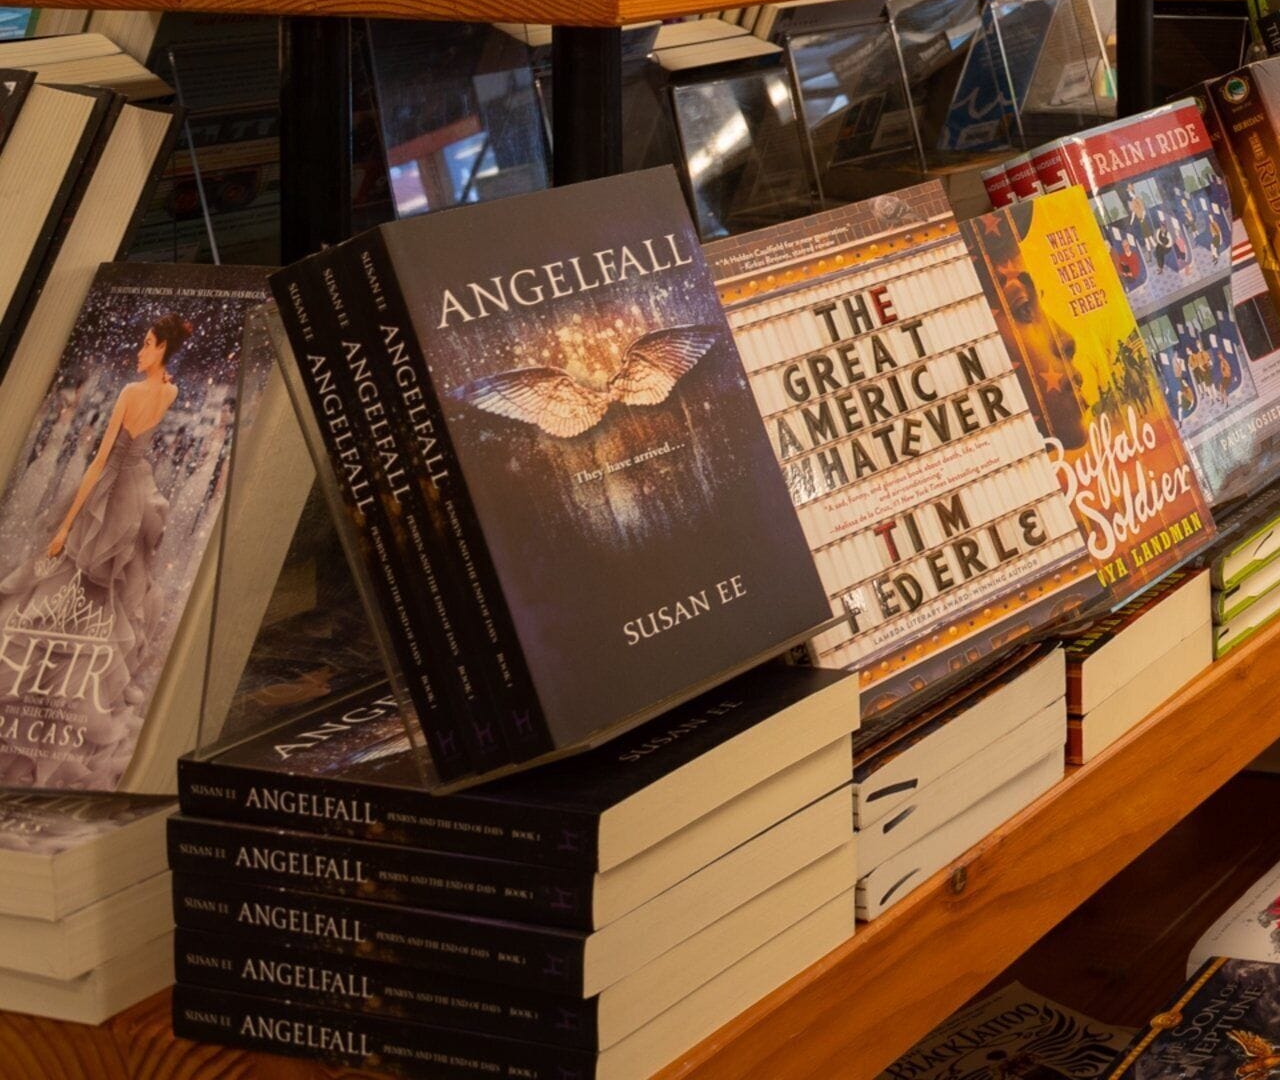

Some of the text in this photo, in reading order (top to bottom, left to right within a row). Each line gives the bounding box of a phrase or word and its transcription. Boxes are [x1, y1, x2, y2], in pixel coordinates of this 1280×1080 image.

[1155, 122, 1201, 155] RIDE
[1044, 225, 1081, 250] WHAT
[1048, 241, 1088, 267] DOES IT
[436, 233, 693, 330] ANGELFALL
[1056, 256, 1096, 285] MEAN
[1068, 273, 1099, 297] TO BE
[813, 285, 899, 343] THE
[1068, 289, 1110, 320] FREE?
[782, 318, 929, 403] GREAT
[307, 352, 375, 516] ANGELFALL
[786, 383, 1013, 506] WHATEVER
[574, 465, 604, 486] They
[604, 457, 631, 477] have
[1043, 404, 1157, 511] Buffalo
[873, 493, 972, 564] TIM
[1075, 460, 1192, 560] Soldier
[1130, 511, 1203, 569] LANDMAN
[841, 507, 1048, 635] FEDERLE
[622, 574, 749, 648] SUSAN EE
[872, 625, 906, 646] LAMBDA
[905, 606, 942, 630] LITERARY
[1008, 558, 1039, 583] AUTHOR
[27, 720, 88, 749] CASS
[245, 786, 378, 827] ANGELFALL
[235, 845, 369, 885] ANGELFALL
[237, 901, 368, 944] ANGELFALL
[241, 957, 376, 1000] ANGELFALL
[240, 1015, 375, 1058] ANGELFALL
